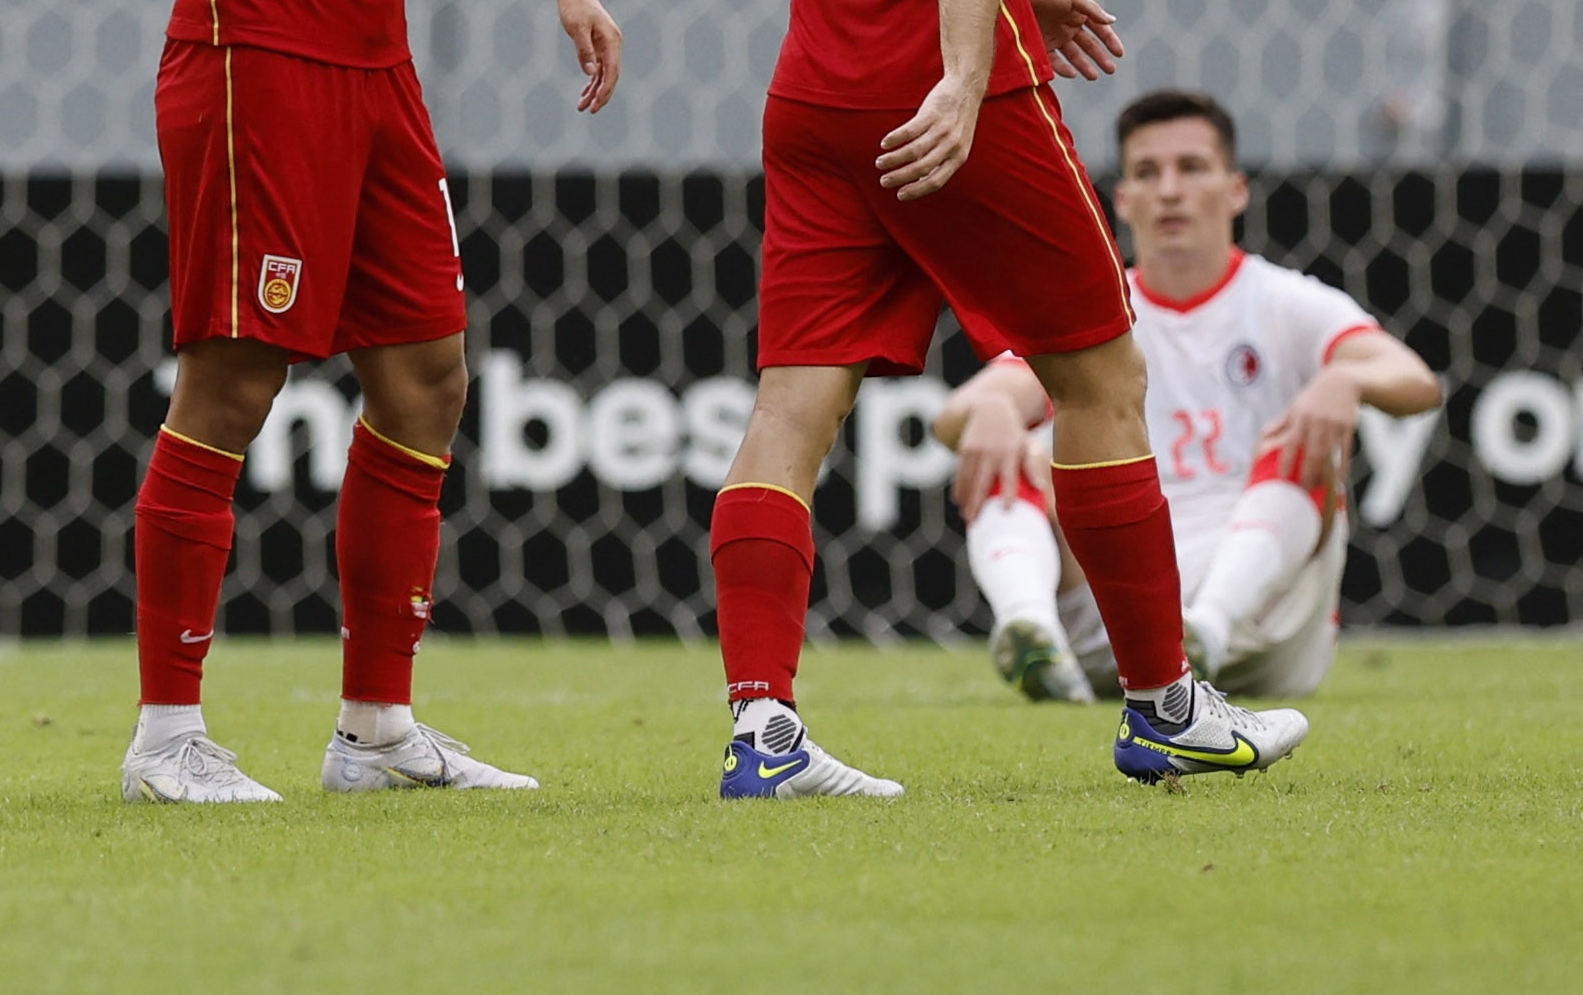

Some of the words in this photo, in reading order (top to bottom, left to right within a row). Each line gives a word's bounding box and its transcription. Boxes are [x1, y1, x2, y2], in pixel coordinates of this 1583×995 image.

[268, 261, 296, 275] CFA
[479, 348, 828, 493] bes
[1171, 408, 1230, 479] 22
[728, 681, 769, 693] CFA
